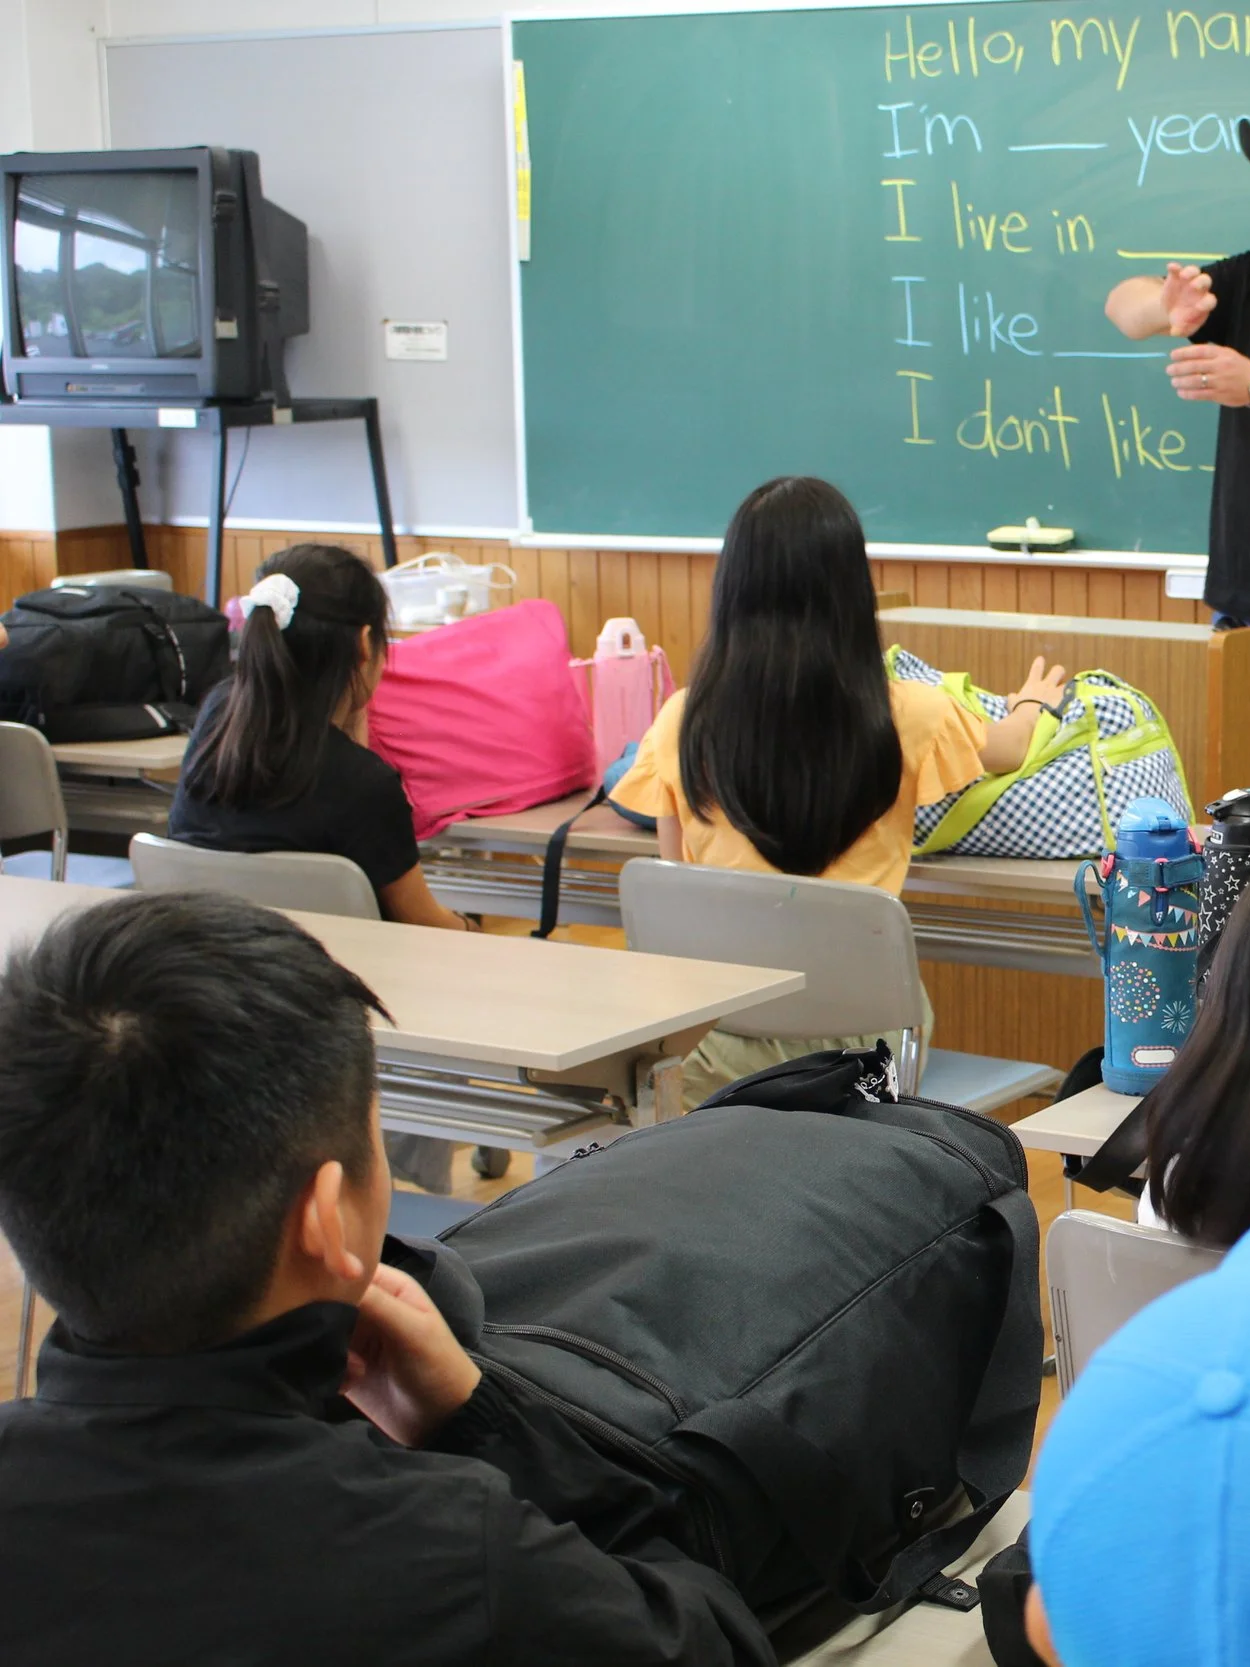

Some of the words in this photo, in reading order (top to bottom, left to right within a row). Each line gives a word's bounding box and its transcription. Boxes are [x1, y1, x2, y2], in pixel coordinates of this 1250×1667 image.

[885, 15, 1024, 83] Hello,
[1050, 16, 1140, 91] my
[878, 101, 983, 160] I'm
[880, 178, 923, 242] I
[951, 180, 1033, 254] live
[1052, 209, 1096, 255] in
[891, 276, 933, 347] I
[958, 282, 1044, 356] like
[896, 370, 936, 445] I
[956, 379, 1080, 471] don't
[1102, 393, 1193, 479] like
